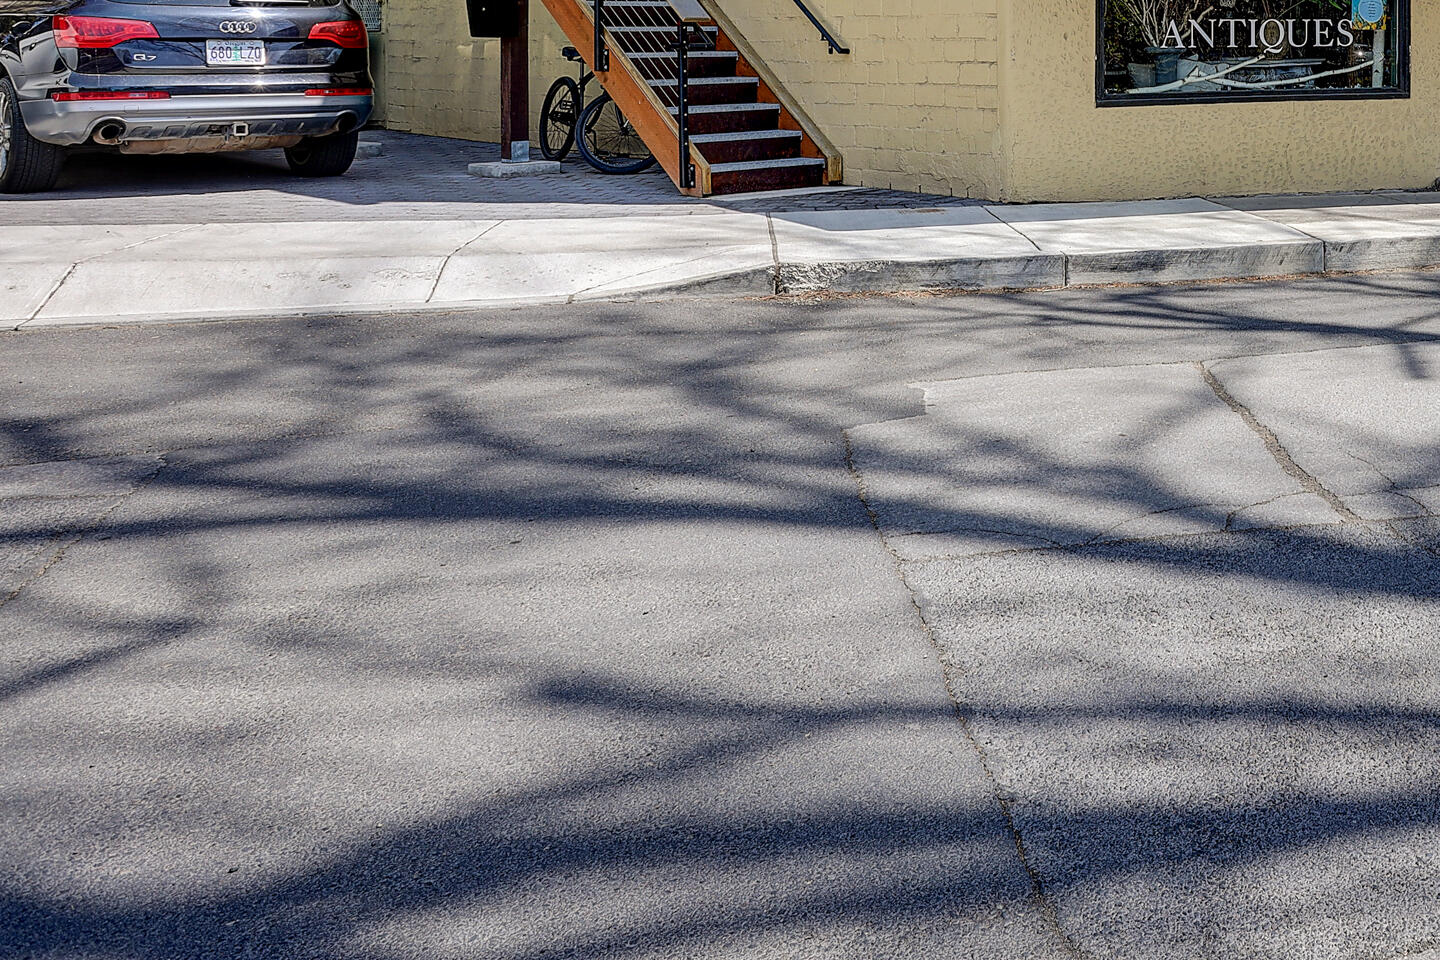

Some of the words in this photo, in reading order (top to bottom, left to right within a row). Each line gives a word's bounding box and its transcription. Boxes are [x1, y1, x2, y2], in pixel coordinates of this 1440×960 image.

[1160, 18, 1354, 54] ANTIQUES
[133, 53, 157, 61] Q7
[211, 46, 232, 59] 680
